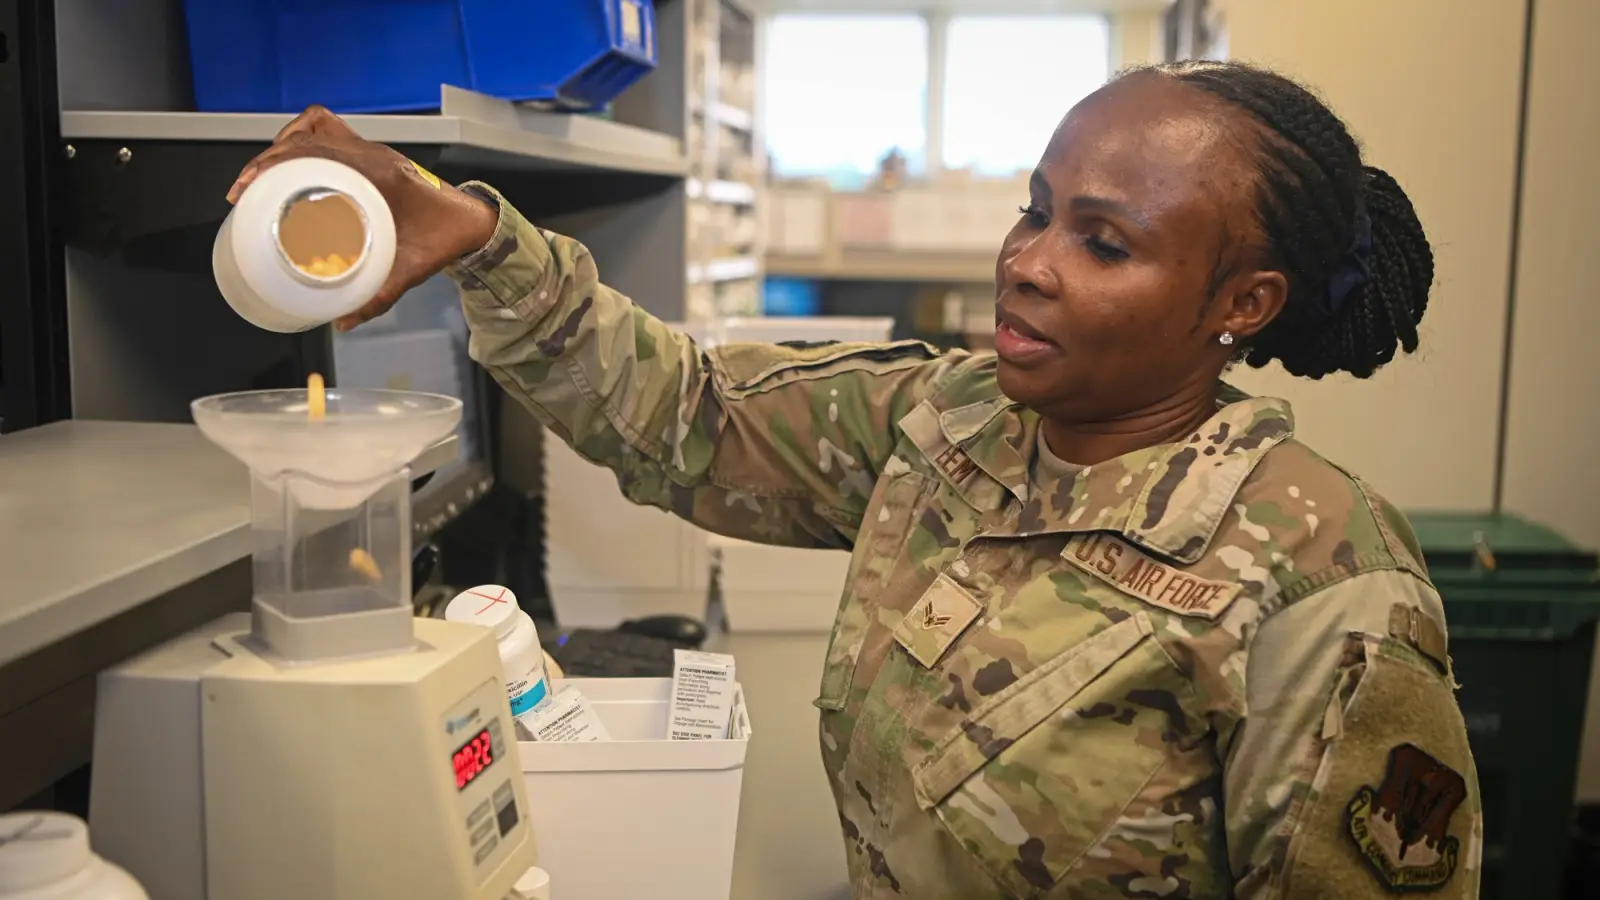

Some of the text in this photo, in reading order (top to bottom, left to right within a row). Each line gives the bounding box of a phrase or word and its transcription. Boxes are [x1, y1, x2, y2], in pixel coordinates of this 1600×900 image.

[1075, 535, 1227, 611] U.S. AIR FORCE
